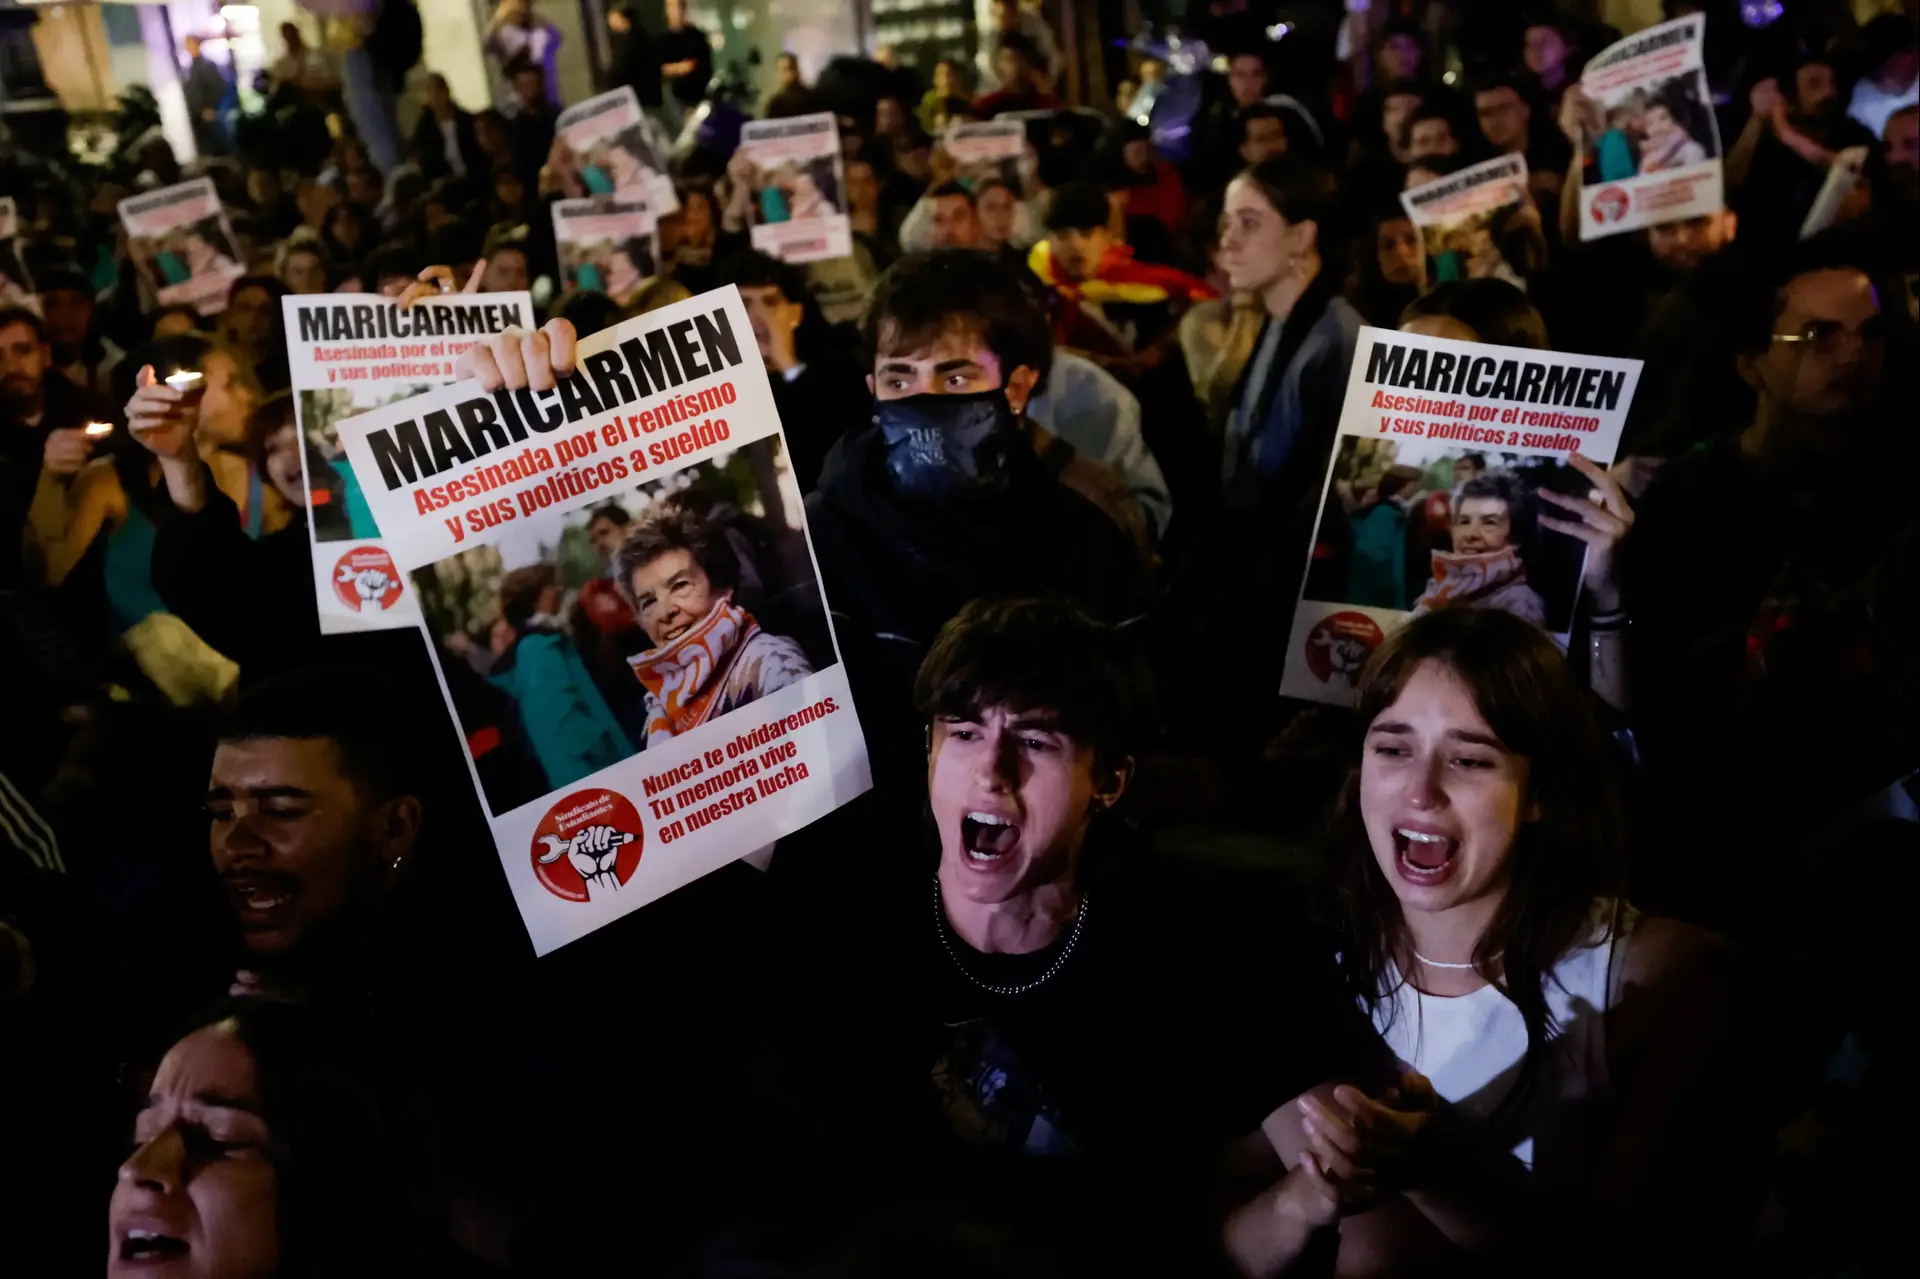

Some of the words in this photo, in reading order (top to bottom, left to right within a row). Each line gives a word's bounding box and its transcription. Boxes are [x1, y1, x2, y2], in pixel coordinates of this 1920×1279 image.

[298, 303, 523, 342] MARICARMEN
[314, 344, 397, 362] Asesinada
[400, 344, 426, 359] por
[430, 341, 445, 356] el
[327, 368, 336, 382] y
[340, 365, 368, 379] sus
[443, 363, 453, 375] a
[1365, 341, 1626, 411] MARICARMEN
[366, 308, 743, 491] MARICARMEN
[1371, 390, 1465, 418] Asesinada
[1467, 404, 1500, 424] por
[1500, 406, 1519, 425] el
[1520, 410, 1600, 432] rentismo
[412, 447, 553, 516] Asesinada
[554, 432, 597, 467] por
[602, 416, 628, 447] el
[630, 382, 737, 438] rentismo
[1379, 416, 1392, 434] y
[1392, 417, 1424, 436] sus
[1427, 420, 1504, 445] políticos
[1506, 431, 1517, 446] a
[1520, 428, 1581, 451] sueldo
[445, 516, 464, 543] y
[465, 498, 516, 534] sus
[516, 454, 628, 518] políticos
[630, 451, 648, 473] a
[648, 418, 731, 466] sueldo
[641, 757, 703, 797] Nunca
[703, 747, 724, 770] te
[725, 697, 840, 760] olvidaremos.
[648, 794, 676, 820] Tu
[677, 758, 759, 810] memoria
[761, 740, 797, 764] vive
[658, 819, 684, 844] en
[685, 785, 756, 834] nuestra
[757, 761, 809, 799] lucha
[555, 799, 598, 823] Sindicato
[597, 794, 611, 804] de
[559, 804, 613, 832] Estudiantes
